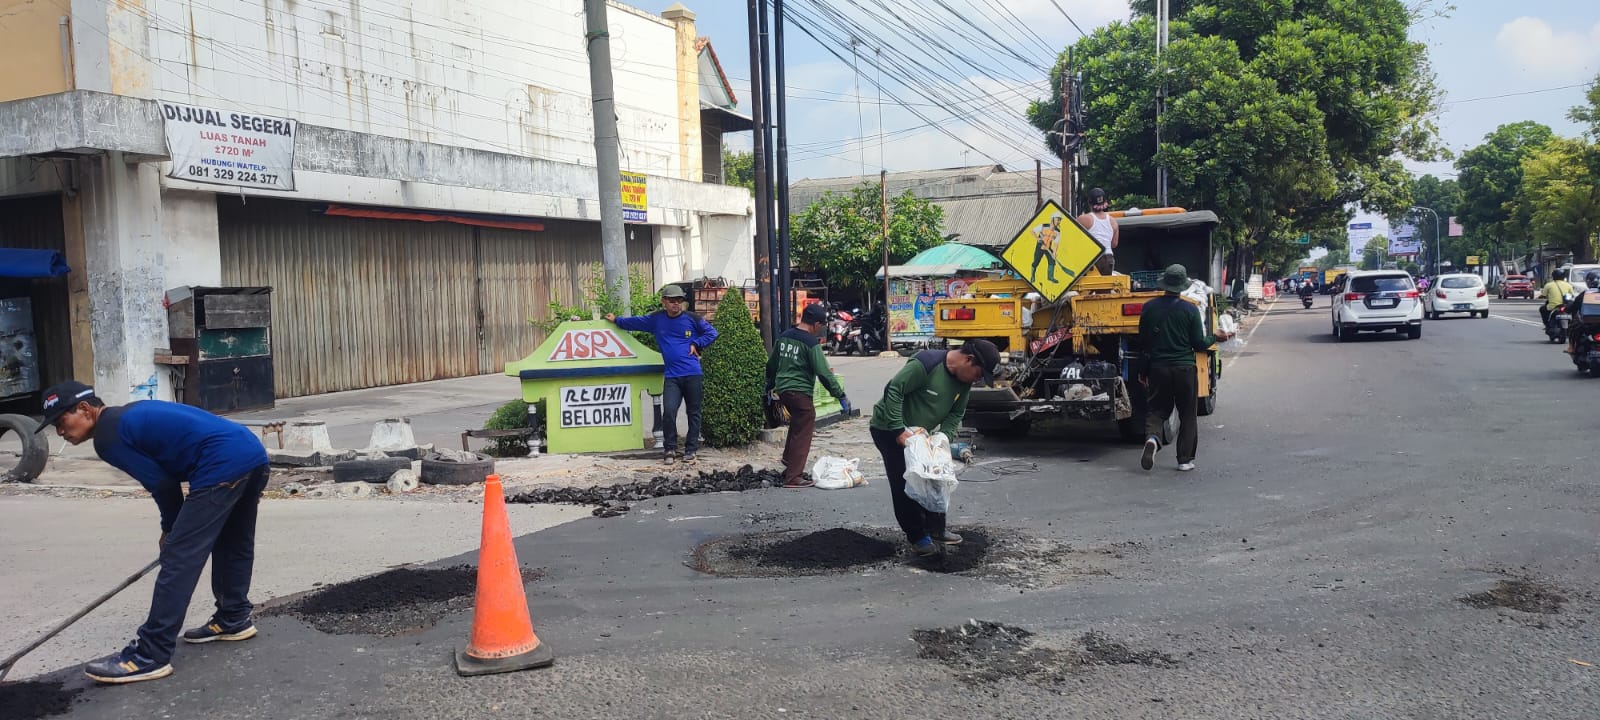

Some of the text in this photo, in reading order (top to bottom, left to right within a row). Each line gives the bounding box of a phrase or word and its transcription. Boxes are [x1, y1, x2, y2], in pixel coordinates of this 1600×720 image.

[163, 104, 292, 137] DIJUAL SEGERA
[200, 130, 267, 147] LUAS TANAH
[215, 145, 239, 157] ±720
[201, 157, 234, 168] HUBUNGI
[189, 165, 278, 185] 081 329 224 377
[550, 330, 634, 356] ASRI
[780, 342, 799, 354] DPU
[562, 407, 631, 426] BELORAN
